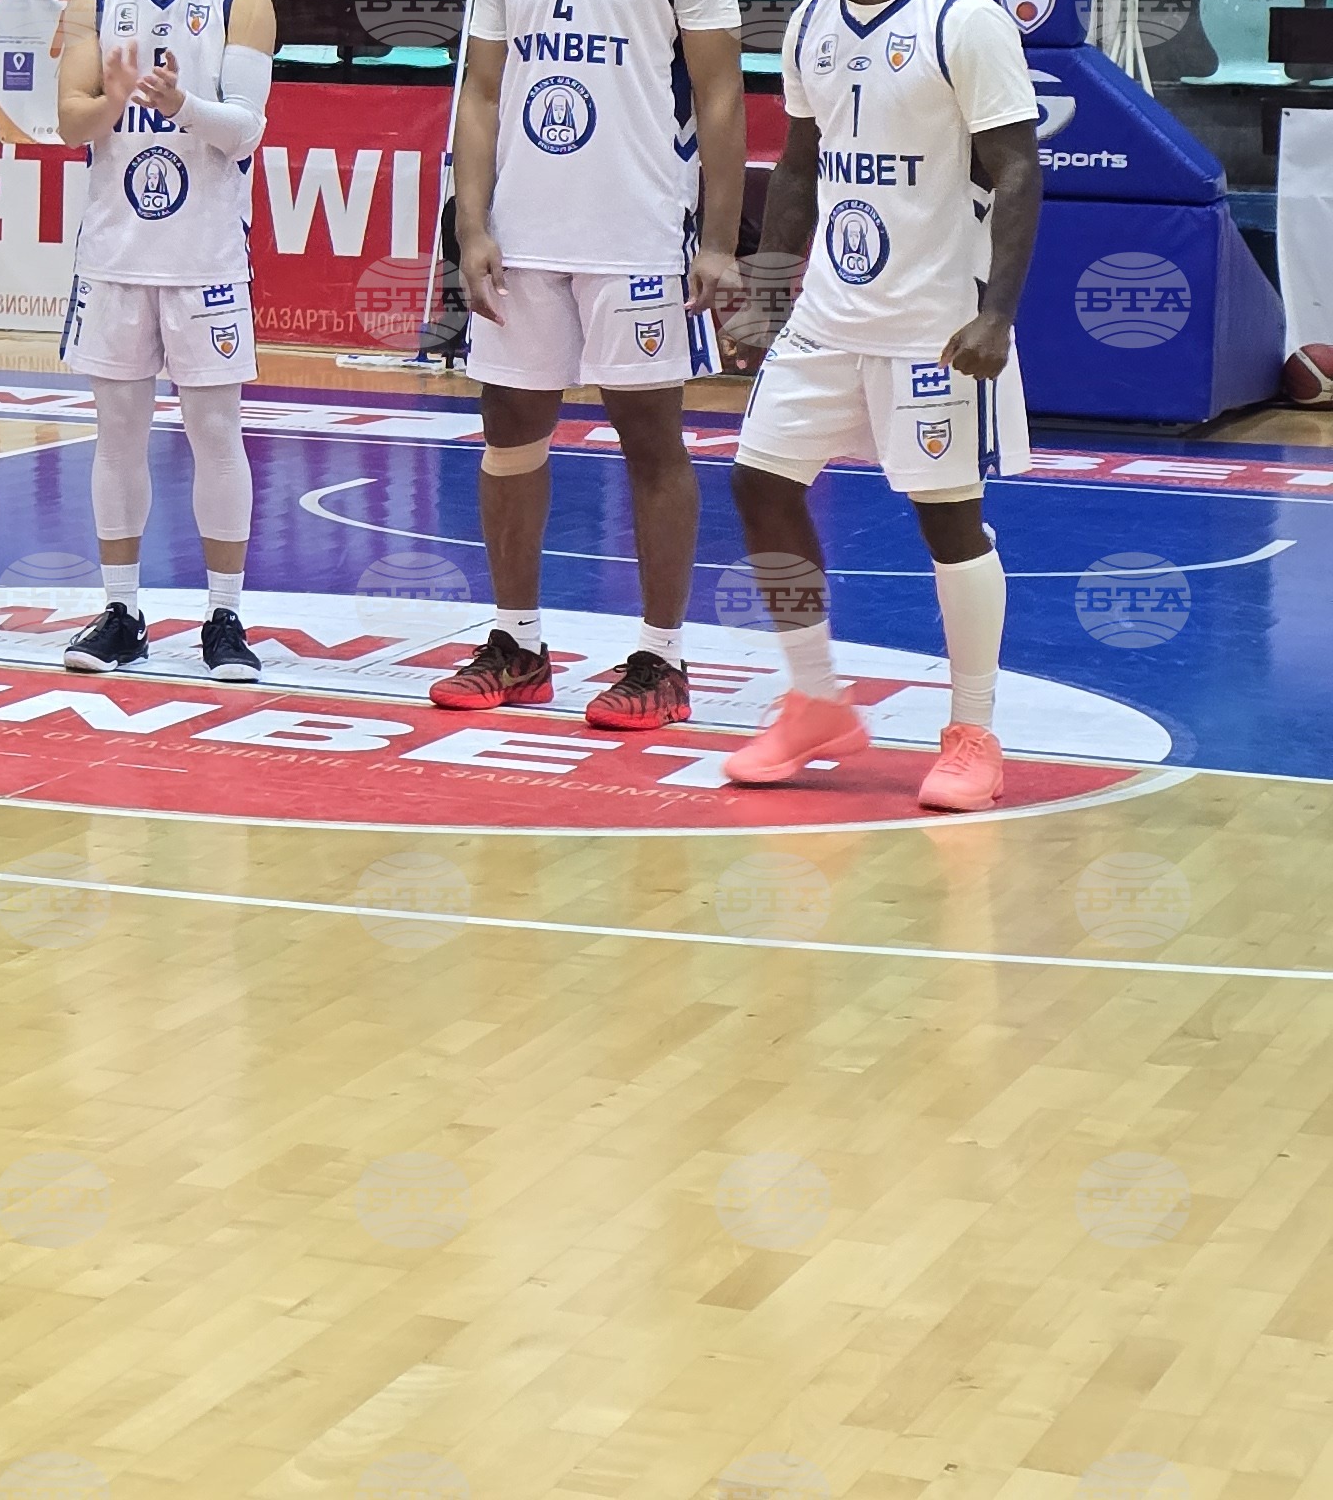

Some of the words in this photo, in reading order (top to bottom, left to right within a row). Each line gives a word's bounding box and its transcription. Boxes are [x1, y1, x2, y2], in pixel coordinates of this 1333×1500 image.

[851, 83, 862, 139] 1
[545, 128, 571, 142] GG
[41, 730, 97, 743] ОТ
[104, 736, 362, 769] РАЗВИВАНЕ
[366, 761, 428, 776] НА
